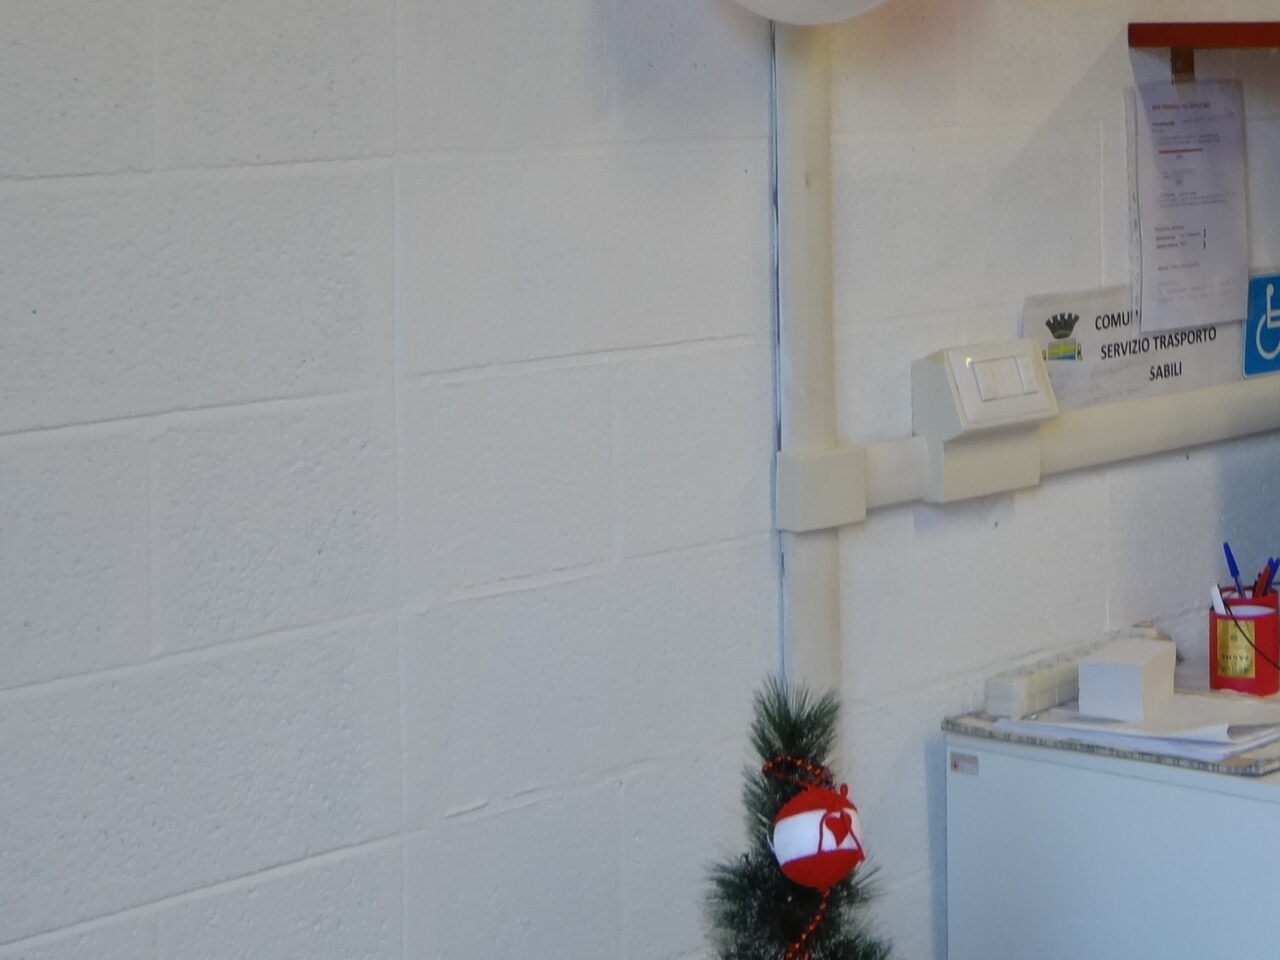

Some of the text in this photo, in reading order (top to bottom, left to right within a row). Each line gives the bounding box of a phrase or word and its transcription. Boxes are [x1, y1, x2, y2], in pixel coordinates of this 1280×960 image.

[1101, 326, 1217, 360] SERVIZIO TRASPORTO
[1149, 361, 1183, 381] SABILI
